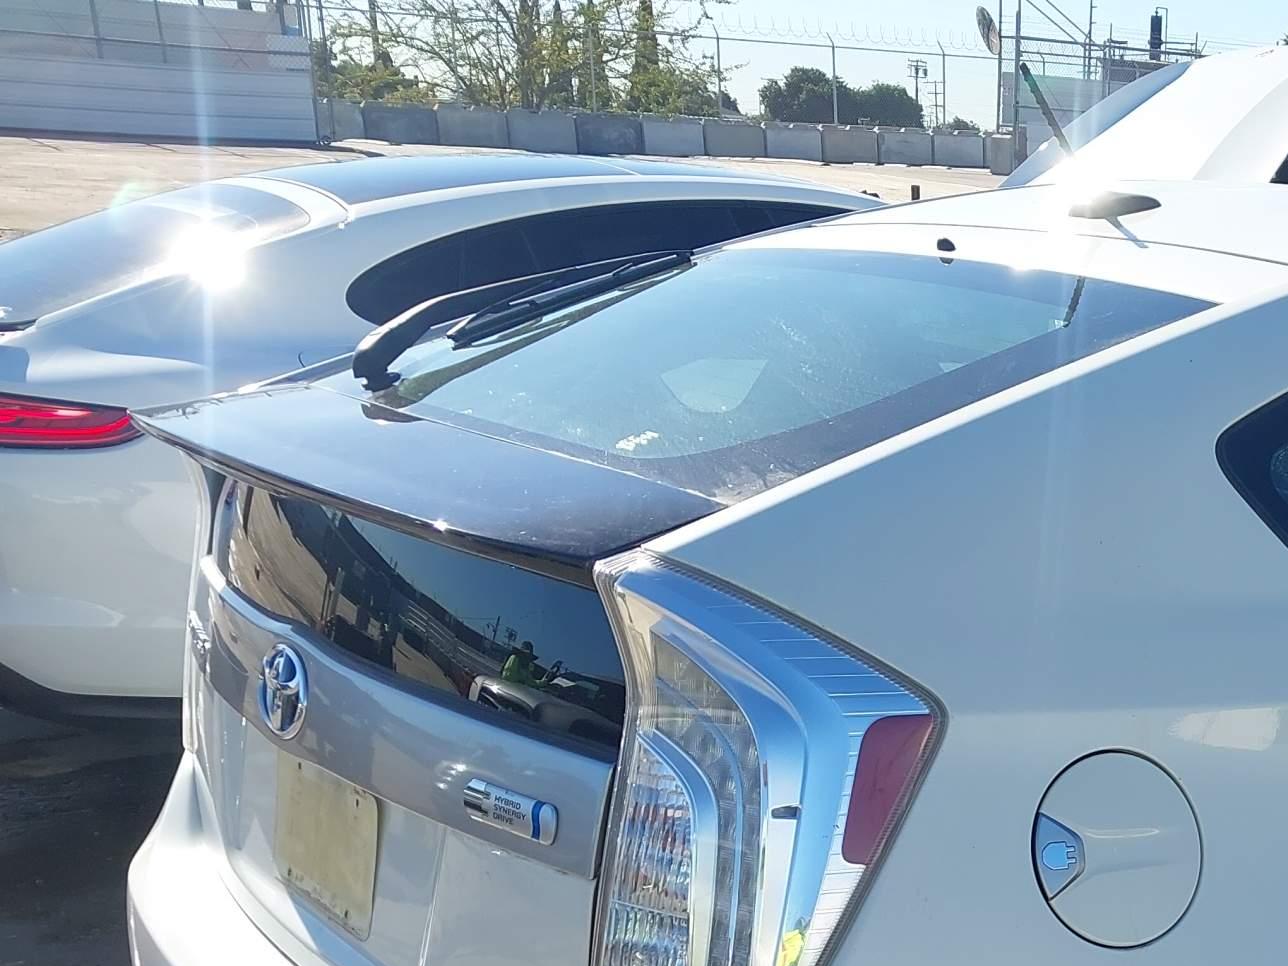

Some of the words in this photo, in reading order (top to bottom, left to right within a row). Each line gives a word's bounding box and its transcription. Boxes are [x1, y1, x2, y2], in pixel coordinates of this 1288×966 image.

[494, 795, 521, 810] HYBRID
[492, 812, 513, 825] DRIVE
[493, 804, 527, 821] SYNERGY
